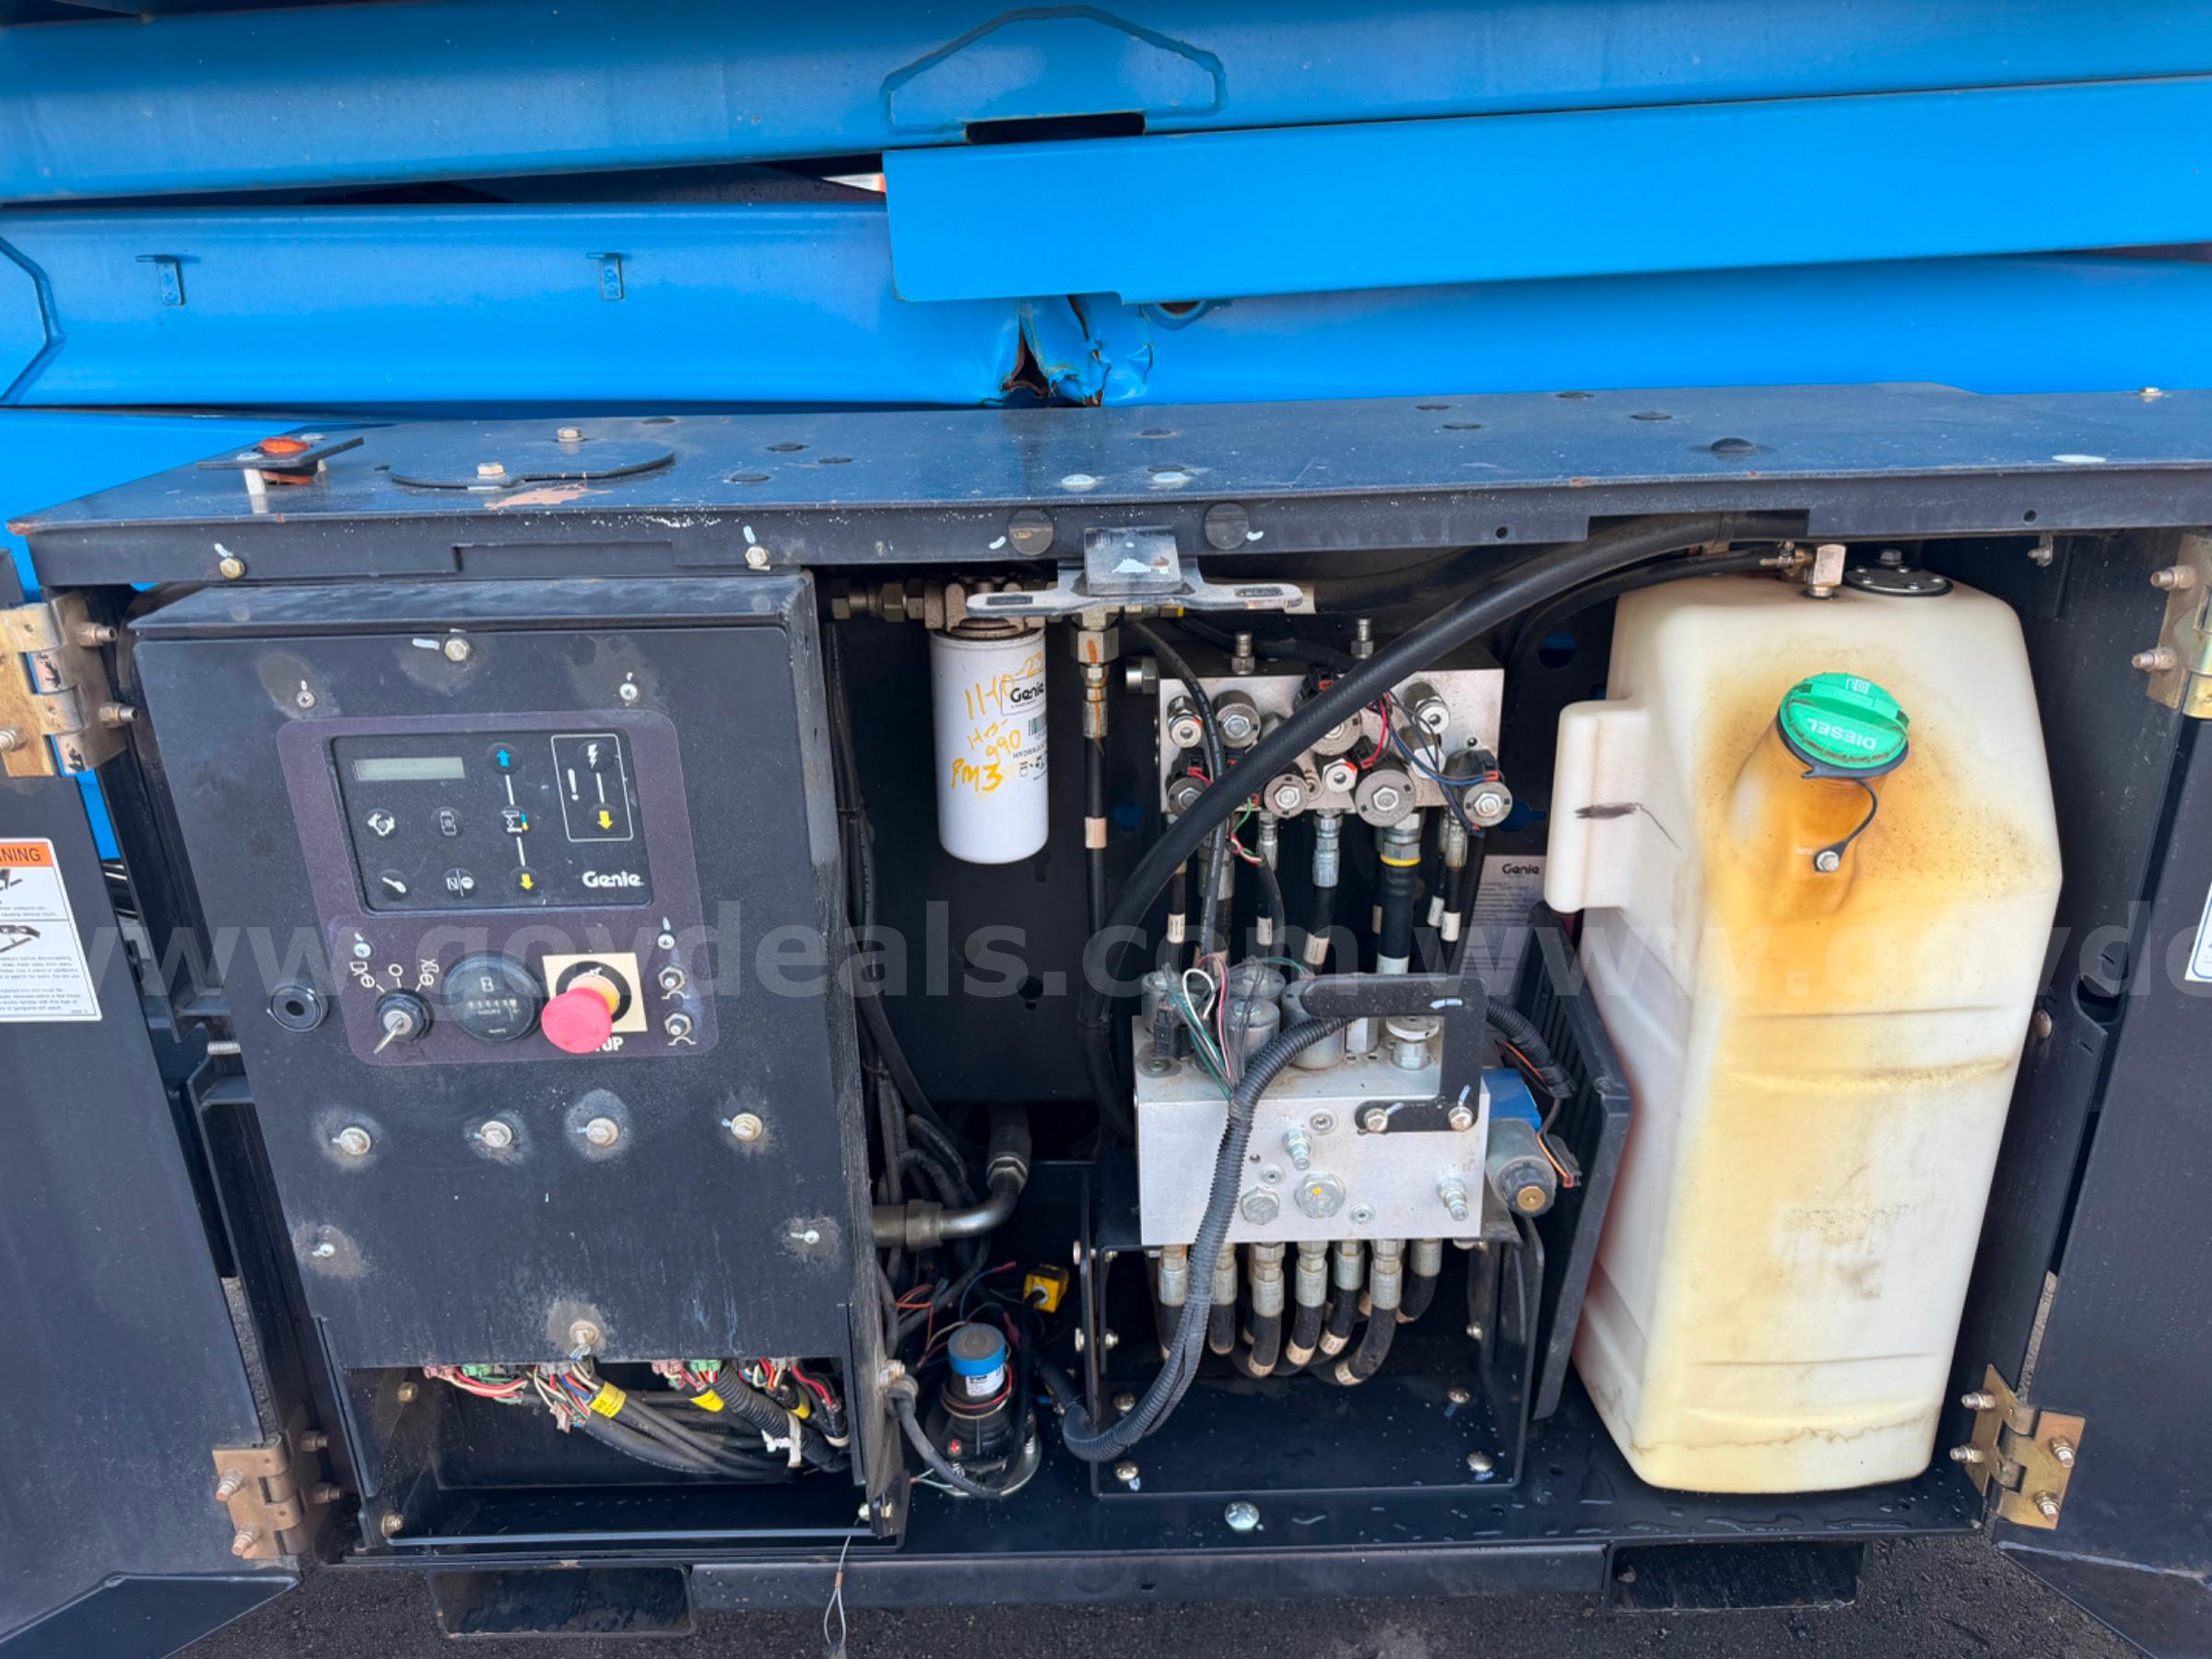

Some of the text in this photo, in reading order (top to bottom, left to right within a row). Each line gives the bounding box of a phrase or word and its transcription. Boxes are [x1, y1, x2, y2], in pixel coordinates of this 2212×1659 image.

[1806, 717, 1877, 751] DIESEL
[0, 847, 41, 863] NING
[1501, 863, 1540, 876] Genie
[582, 870, 645, 888] Genie
